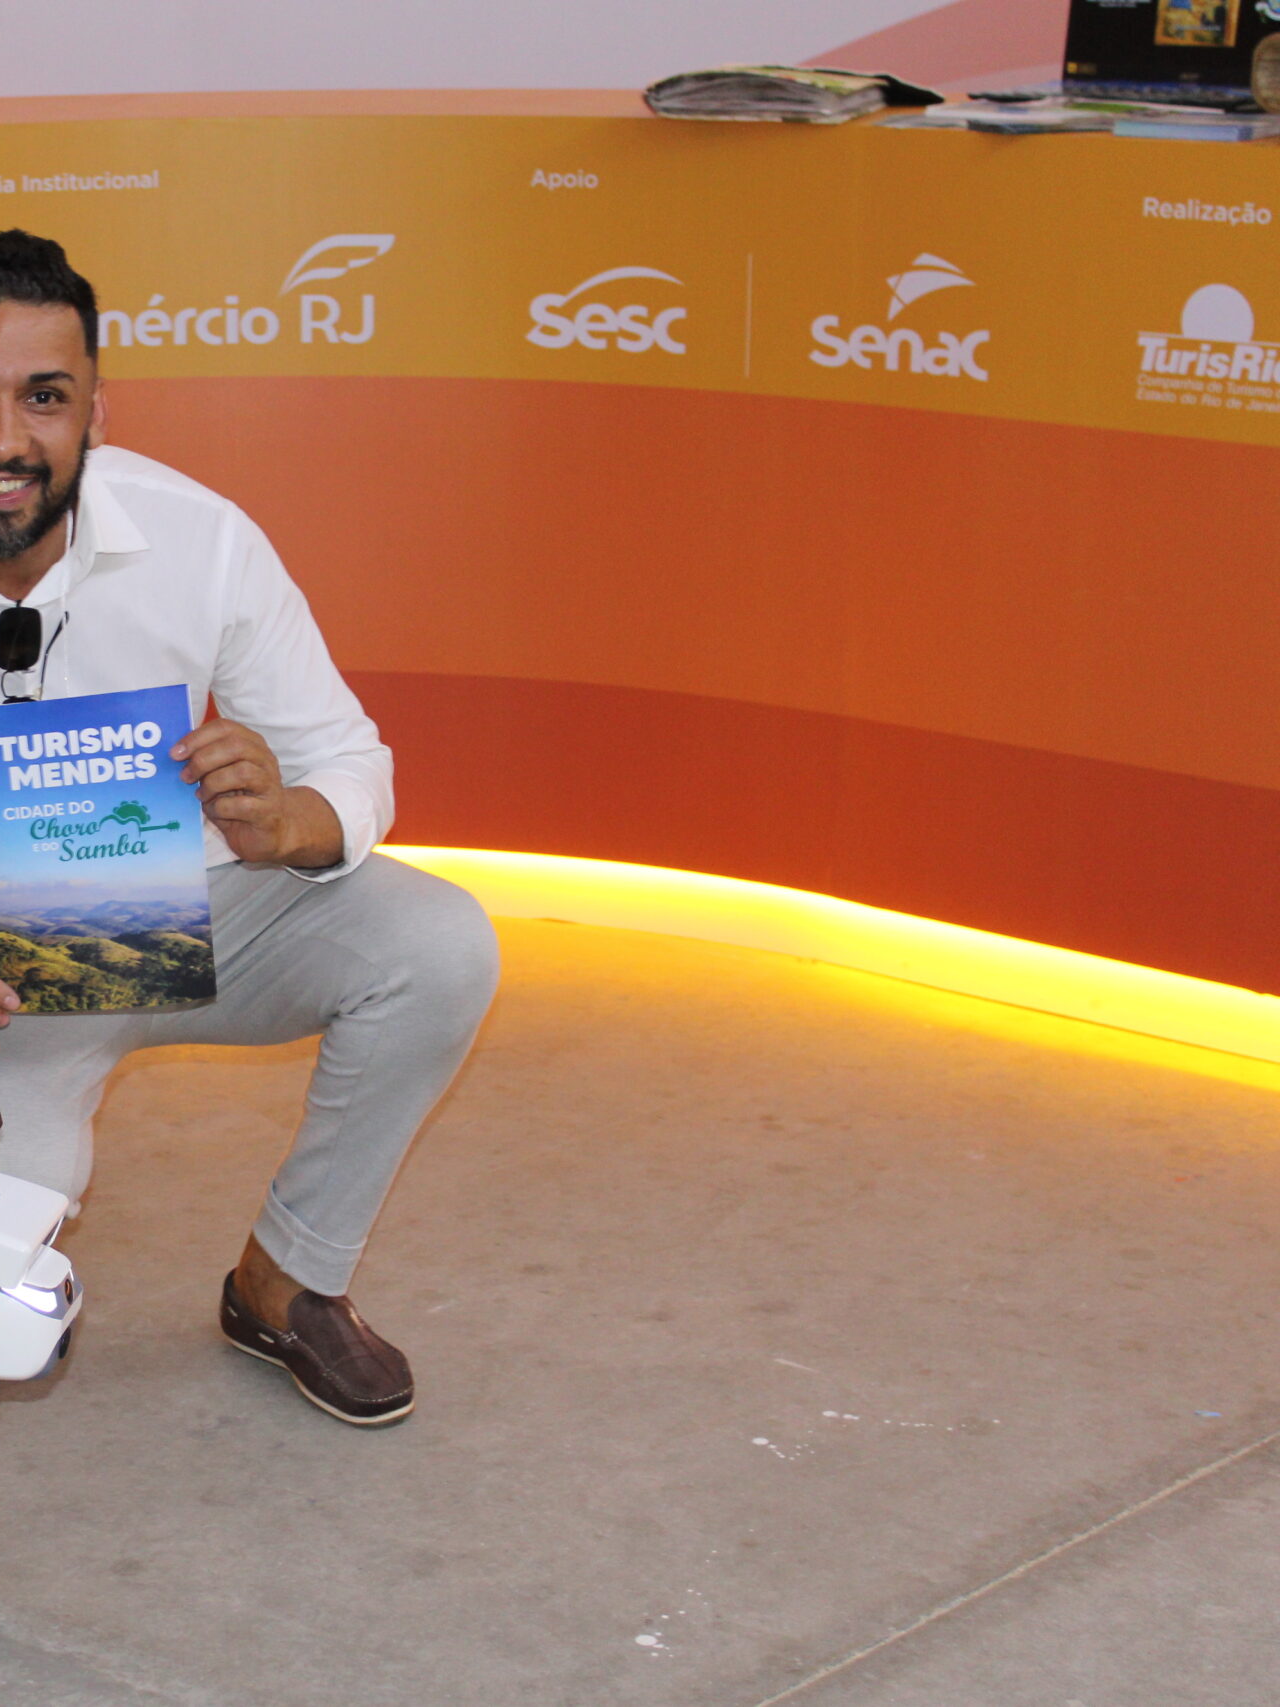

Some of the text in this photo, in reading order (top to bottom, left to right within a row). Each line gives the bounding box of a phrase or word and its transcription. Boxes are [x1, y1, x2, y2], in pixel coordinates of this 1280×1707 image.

[21, 170, 160, 193] Institucional
[531, 169, 599, 190] Apoio
[1142, 197, 1272, 226] Realização
[97, 294, 376, 348] mércio RJ
[809, 314, 990, 382] Senac
[8, 753, 157, 791] MENDES
[3, 800, 95, 821] CIDADE DO
[30, 818, 100, 840] Choro
[59, 834, 148, 862] Samba
